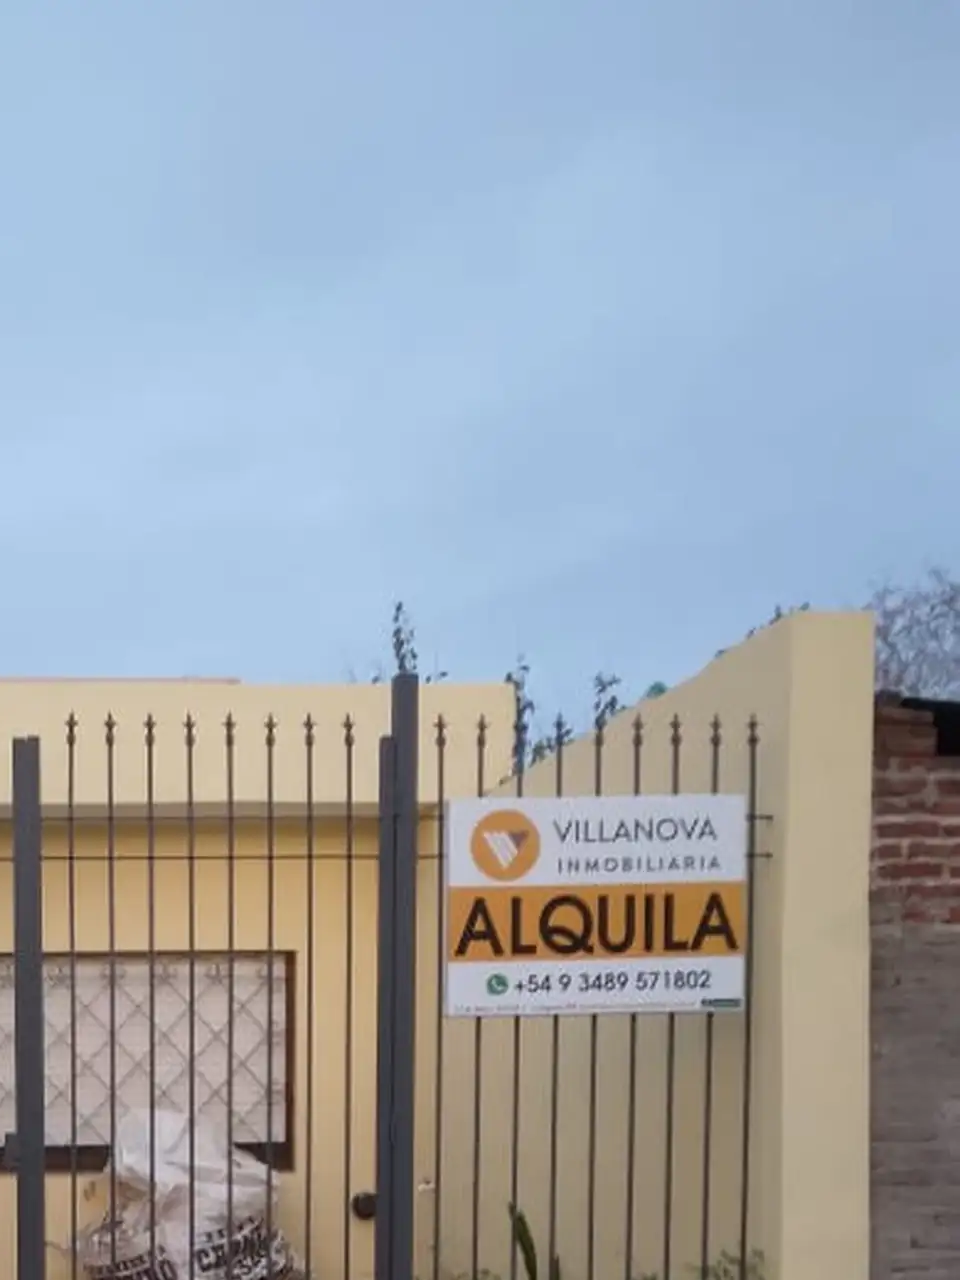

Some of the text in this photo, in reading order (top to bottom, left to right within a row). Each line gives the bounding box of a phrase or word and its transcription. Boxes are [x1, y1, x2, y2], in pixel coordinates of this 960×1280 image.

[552, 815, 718, 843] VILLANOVA
[557, 855, 721, 875] INMOBILIARIA
[454, 892, 739, 957] ALQUILA
[514, 969, 712, 993] +54 9 3489 571802
